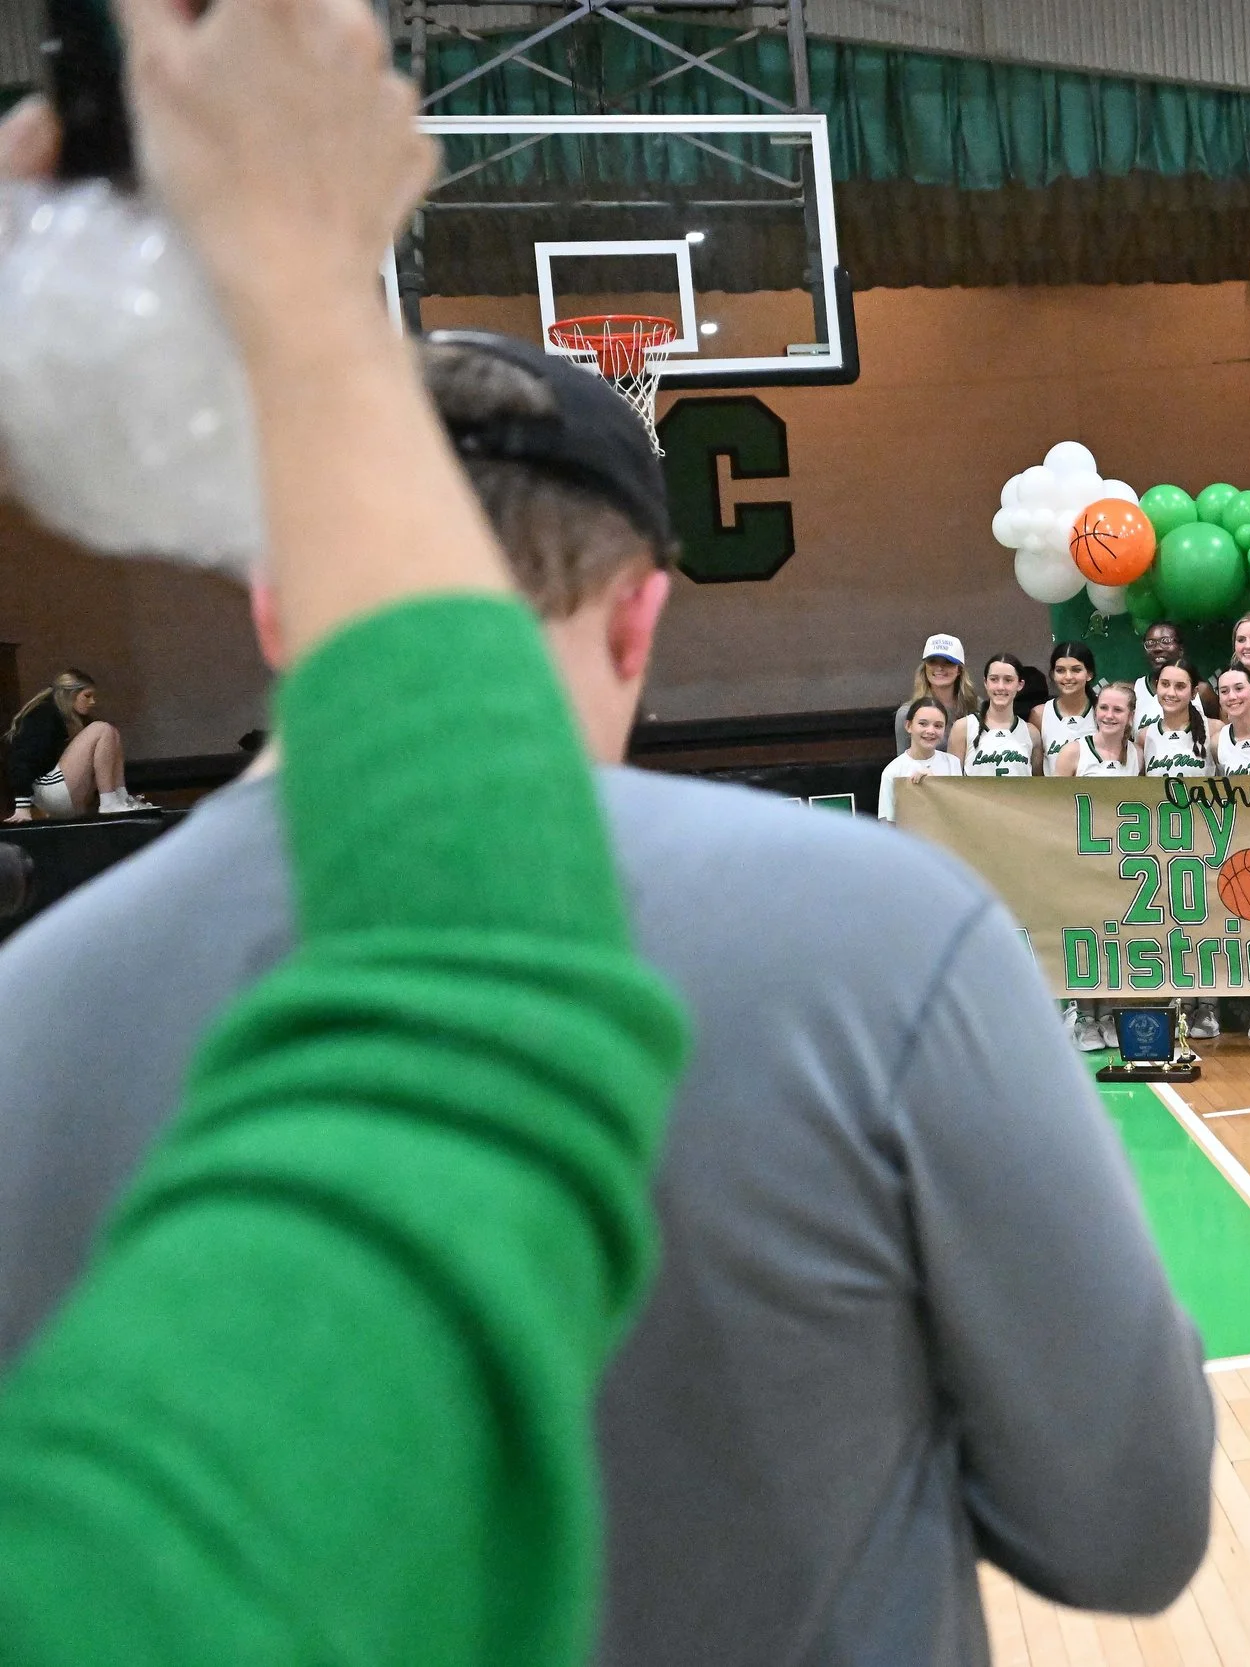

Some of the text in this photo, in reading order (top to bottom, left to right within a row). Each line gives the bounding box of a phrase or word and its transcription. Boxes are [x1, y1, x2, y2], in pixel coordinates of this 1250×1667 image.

[655, 395, 797, 585] C
[973, 750, 1002, 767] Lady
[1146, 755, 1174, 772] Lady
[1074, 780, 1236, 870] Lady
[1118, 854, 1209, 926] 20
